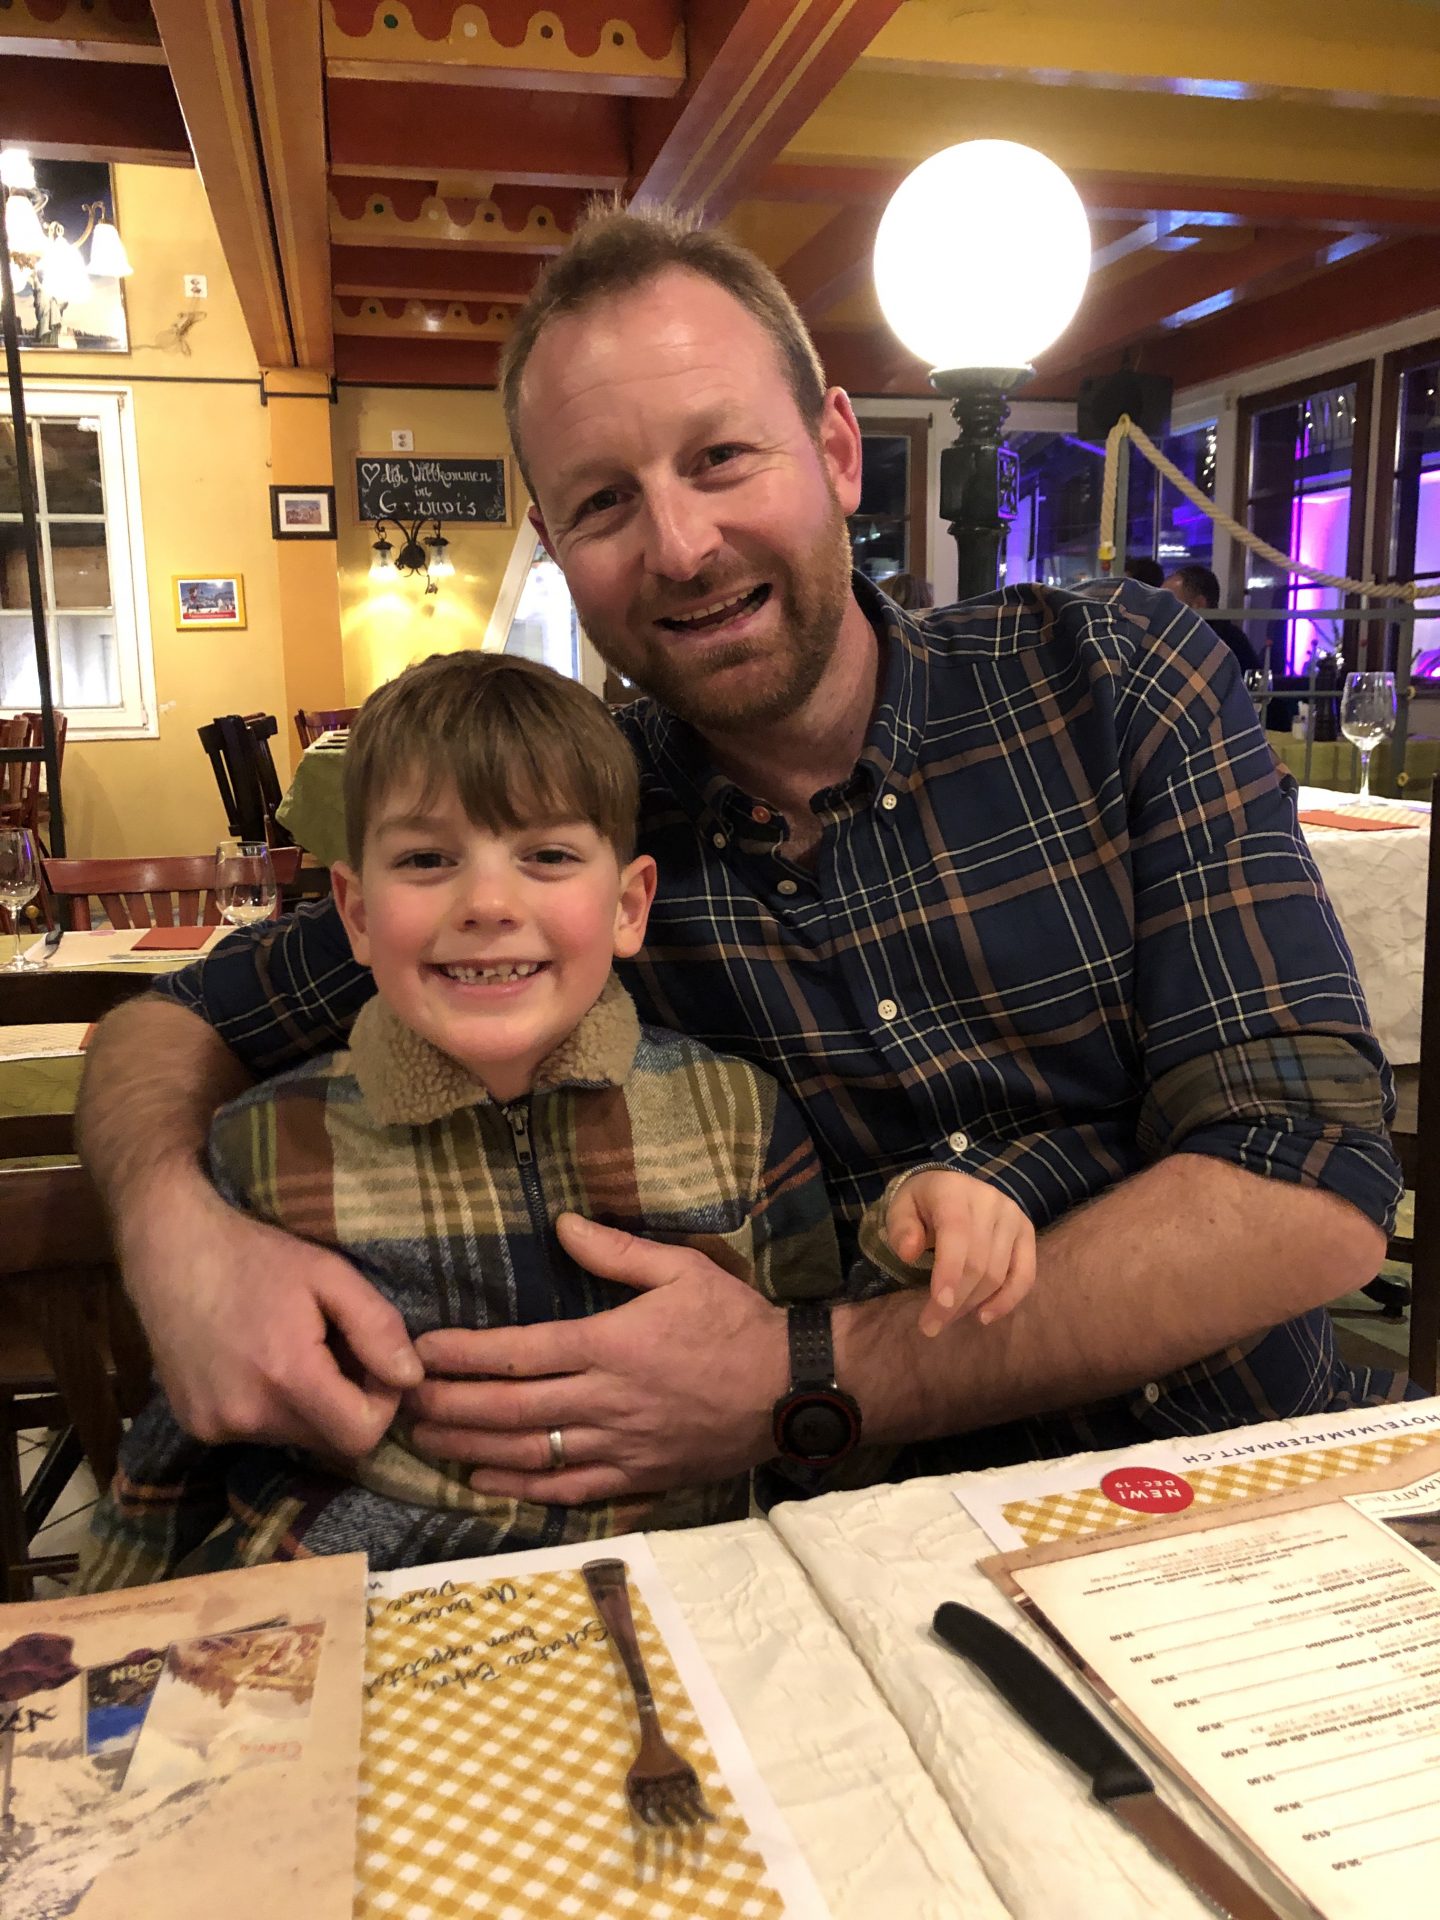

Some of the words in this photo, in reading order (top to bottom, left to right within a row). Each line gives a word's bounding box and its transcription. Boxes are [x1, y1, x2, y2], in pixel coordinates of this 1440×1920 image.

[408, 460, 492, 488] Willkommen
[1136, 1479, 1175, 1487] DEC.
[1118, 1489, 1181, 1499] NEW!
[1384, 1586, 1437, 1602] Hamburger
